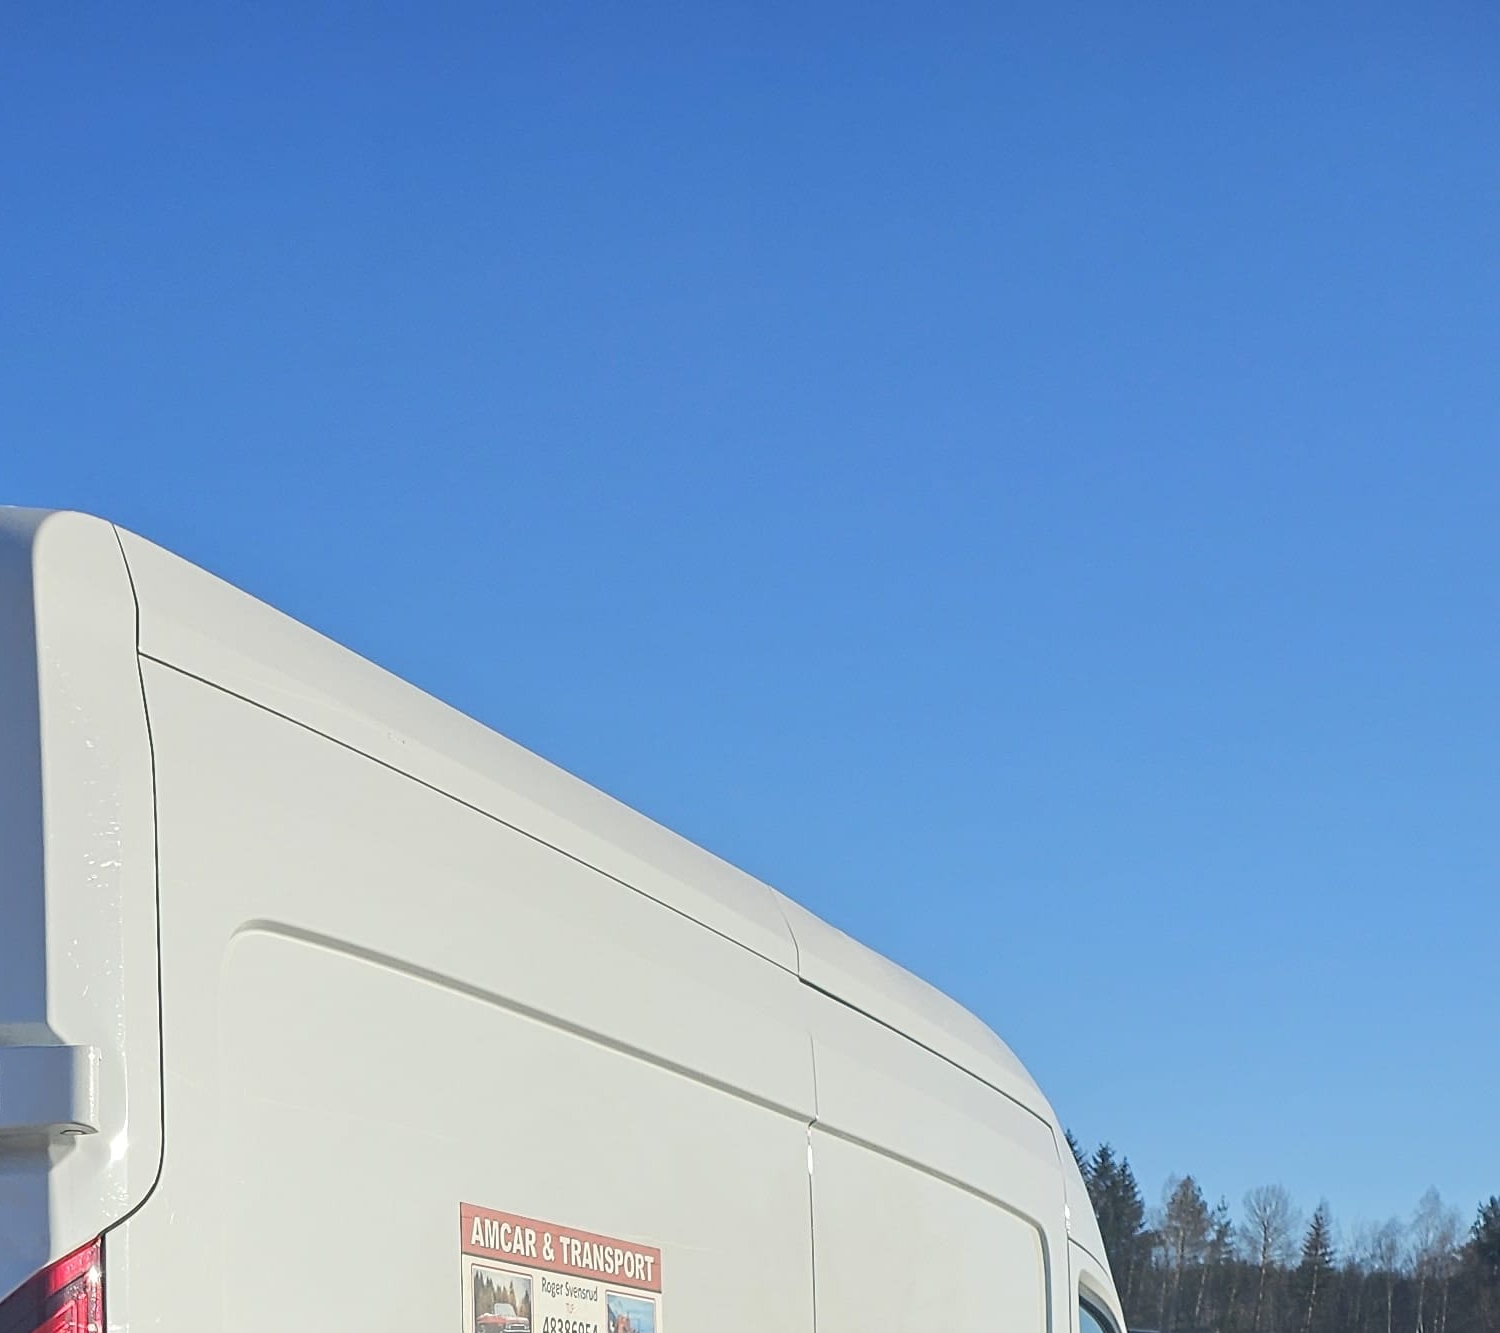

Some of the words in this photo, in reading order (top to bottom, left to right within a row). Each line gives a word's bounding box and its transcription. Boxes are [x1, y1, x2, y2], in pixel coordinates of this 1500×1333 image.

[470, 1216, 537, 1258] AMCAR
[542, 1232, 555, 1262] &
[559, 1235, 655, 1282] TRANSPORT
[541, 1276, 564, 1298] Roger
